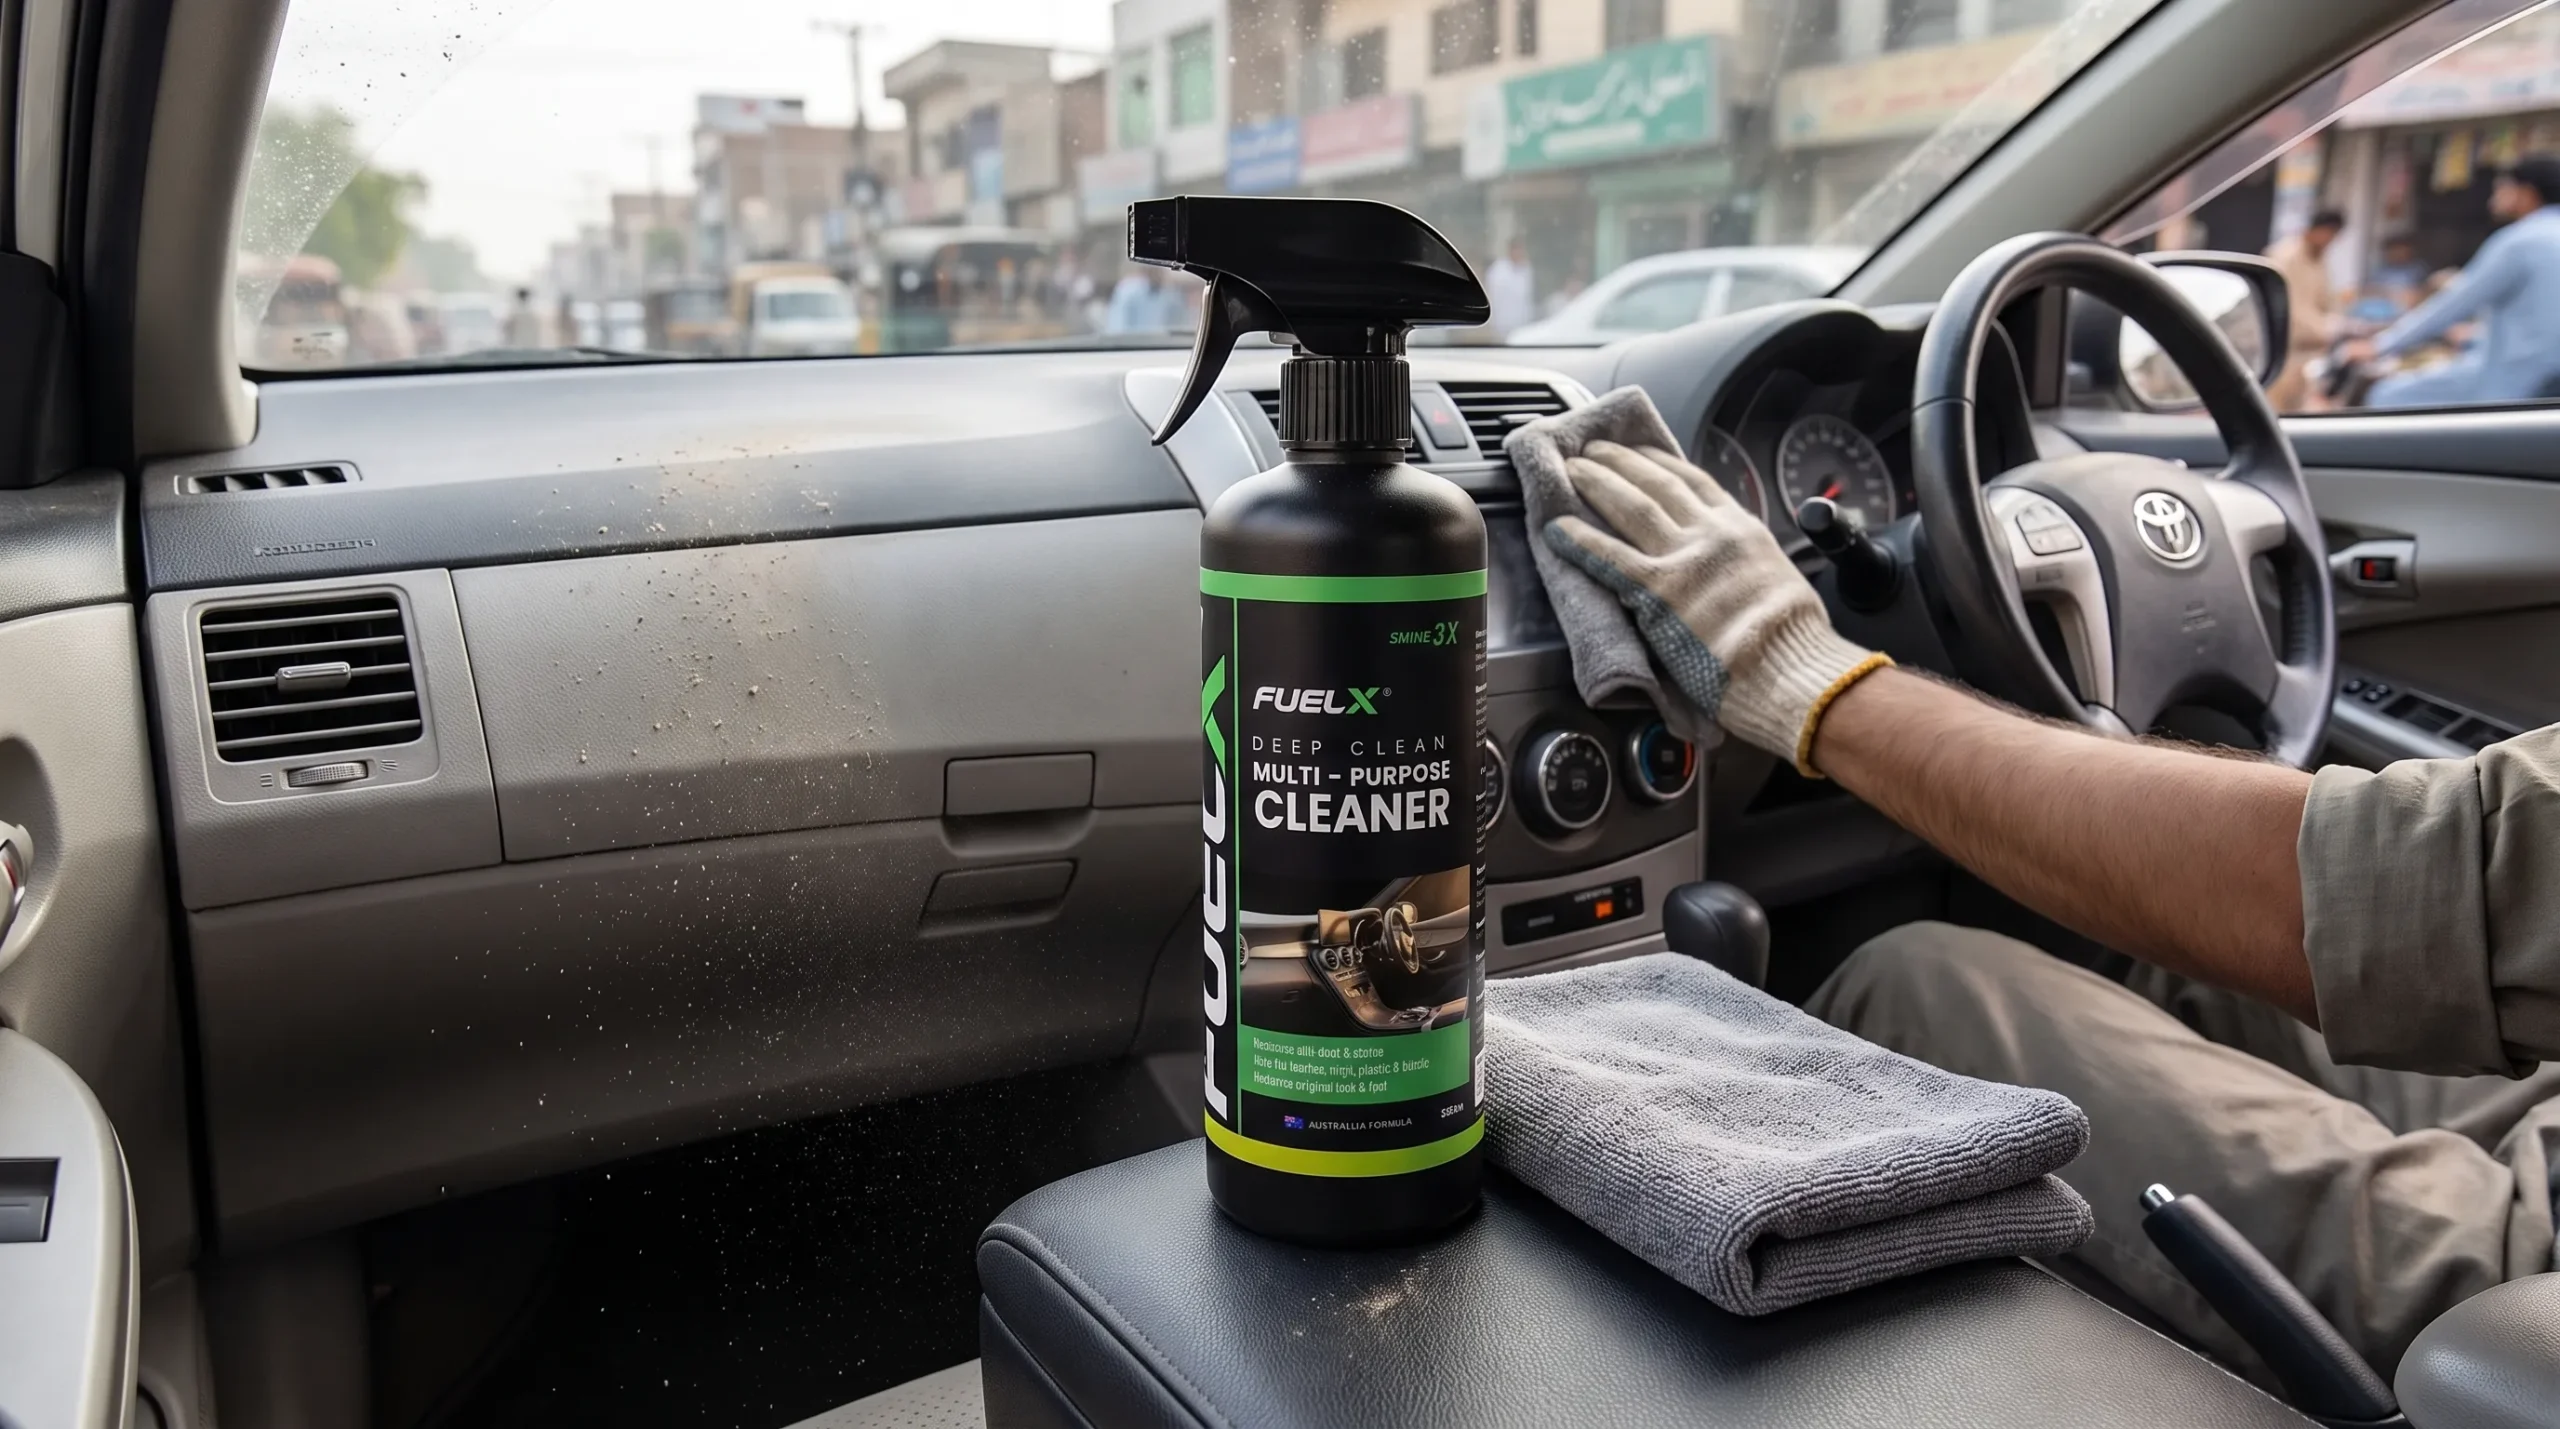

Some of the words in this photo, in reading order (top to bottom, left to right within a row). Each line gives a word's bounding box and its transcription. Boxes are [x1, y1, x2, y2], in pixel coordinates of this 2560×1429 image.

[1433, 621, 1459, 646] 3X
[1252, 736, 1322, 755] DEEP
[1350, 735, 1445, 756] CLEAN
[1253, 761, 1320, 785] MULTI
[1350, 760, 1450, 786] PURPOSE
[1254, 788, 1450, 833] CLEANER
[1358, 1062, 1391, 1078] plastic
[1358, 1081, 1366, 1093] &
[1308, 1121, 1366, 1131] AUSTRALLIA
[1369, 1118, 1412, 1130] FORMULA
